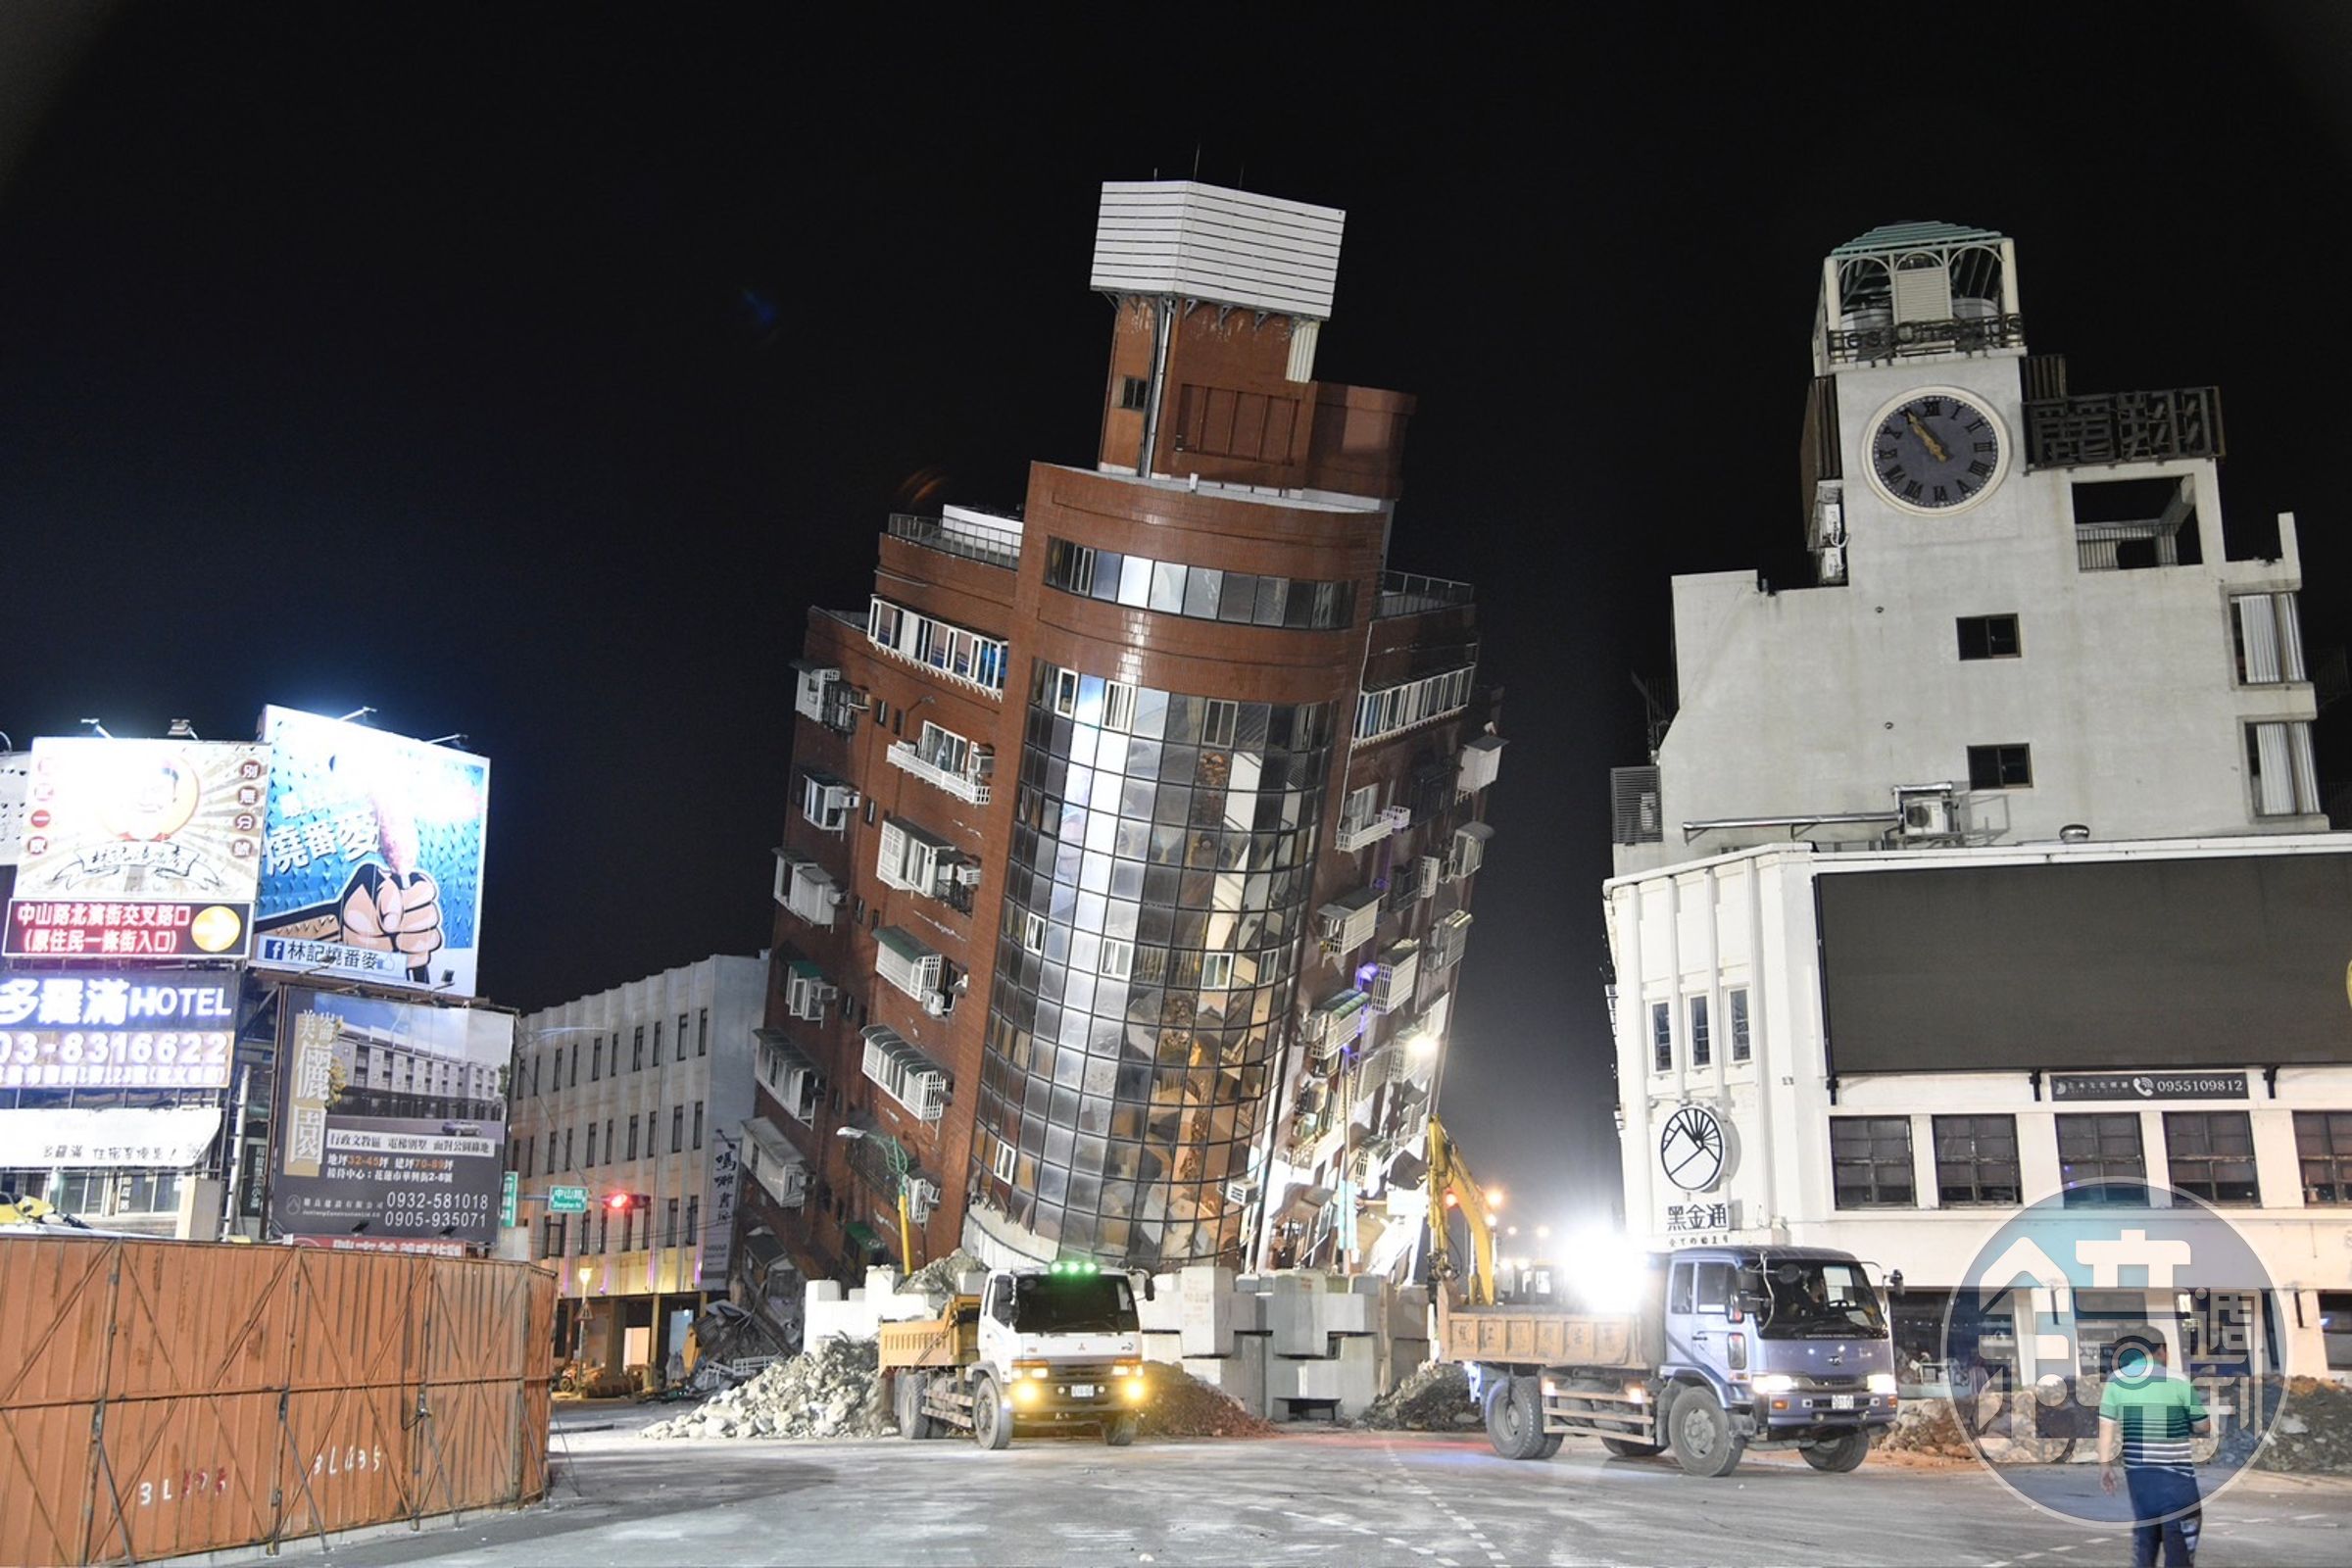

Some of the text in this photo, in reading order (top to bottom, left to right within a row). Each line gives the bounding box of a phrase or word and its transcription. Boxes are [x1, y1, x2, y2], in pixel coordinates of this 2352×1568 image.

[287, 941, 379, 970] 林記燒番麥
[0, 978, 232, 1025] 多羅滿 HOTEL
[2156, 1079, 2243, 1093] 0955109812
[329, 1132, 382, 1150] 行政文教區
[386, 1191, 489, 1211] 0932-581018
[384, 1209, 488, 1228] 0905-935071
[1667, 1202, 1727, 1231] 黑金通
